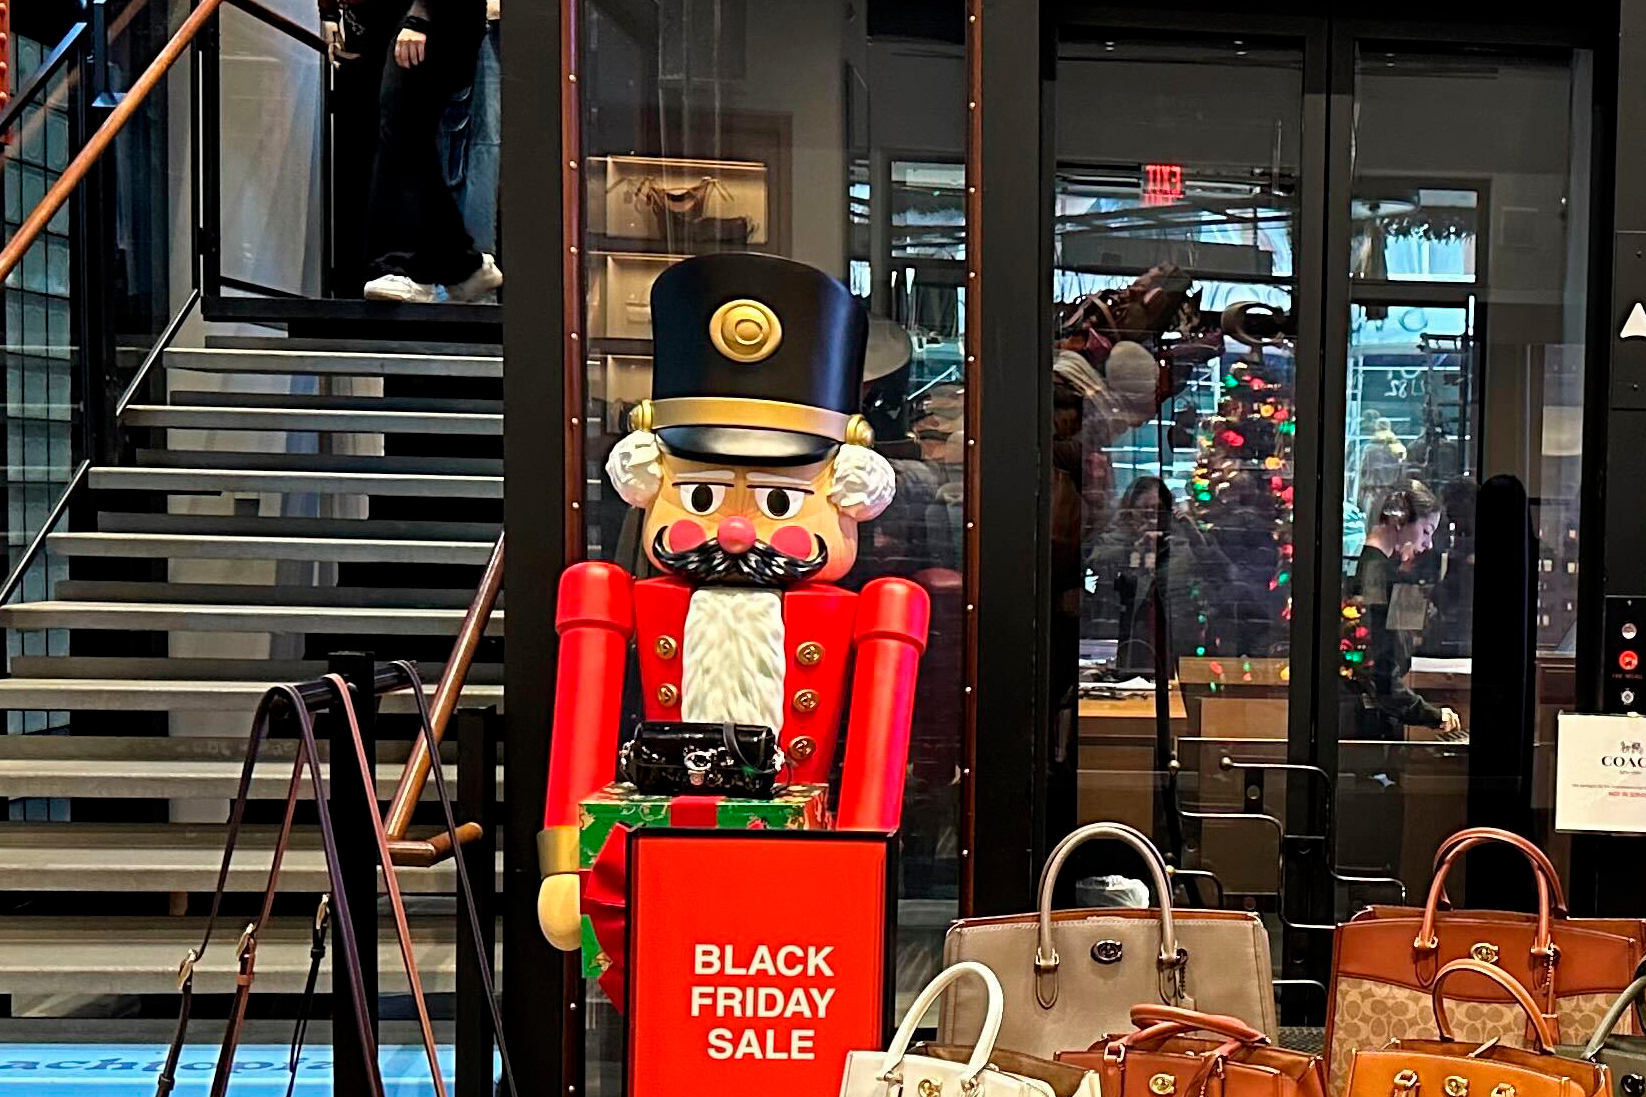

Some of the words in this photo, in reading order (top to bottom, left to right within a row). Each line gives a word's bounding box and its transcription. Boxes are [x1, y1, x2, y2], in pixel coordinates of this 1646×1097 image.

[694, 943, 835, 977] BLACK
[690, 986, 836, 1019] FRIDAY
[707, 1027, 816, 1060] SALE
